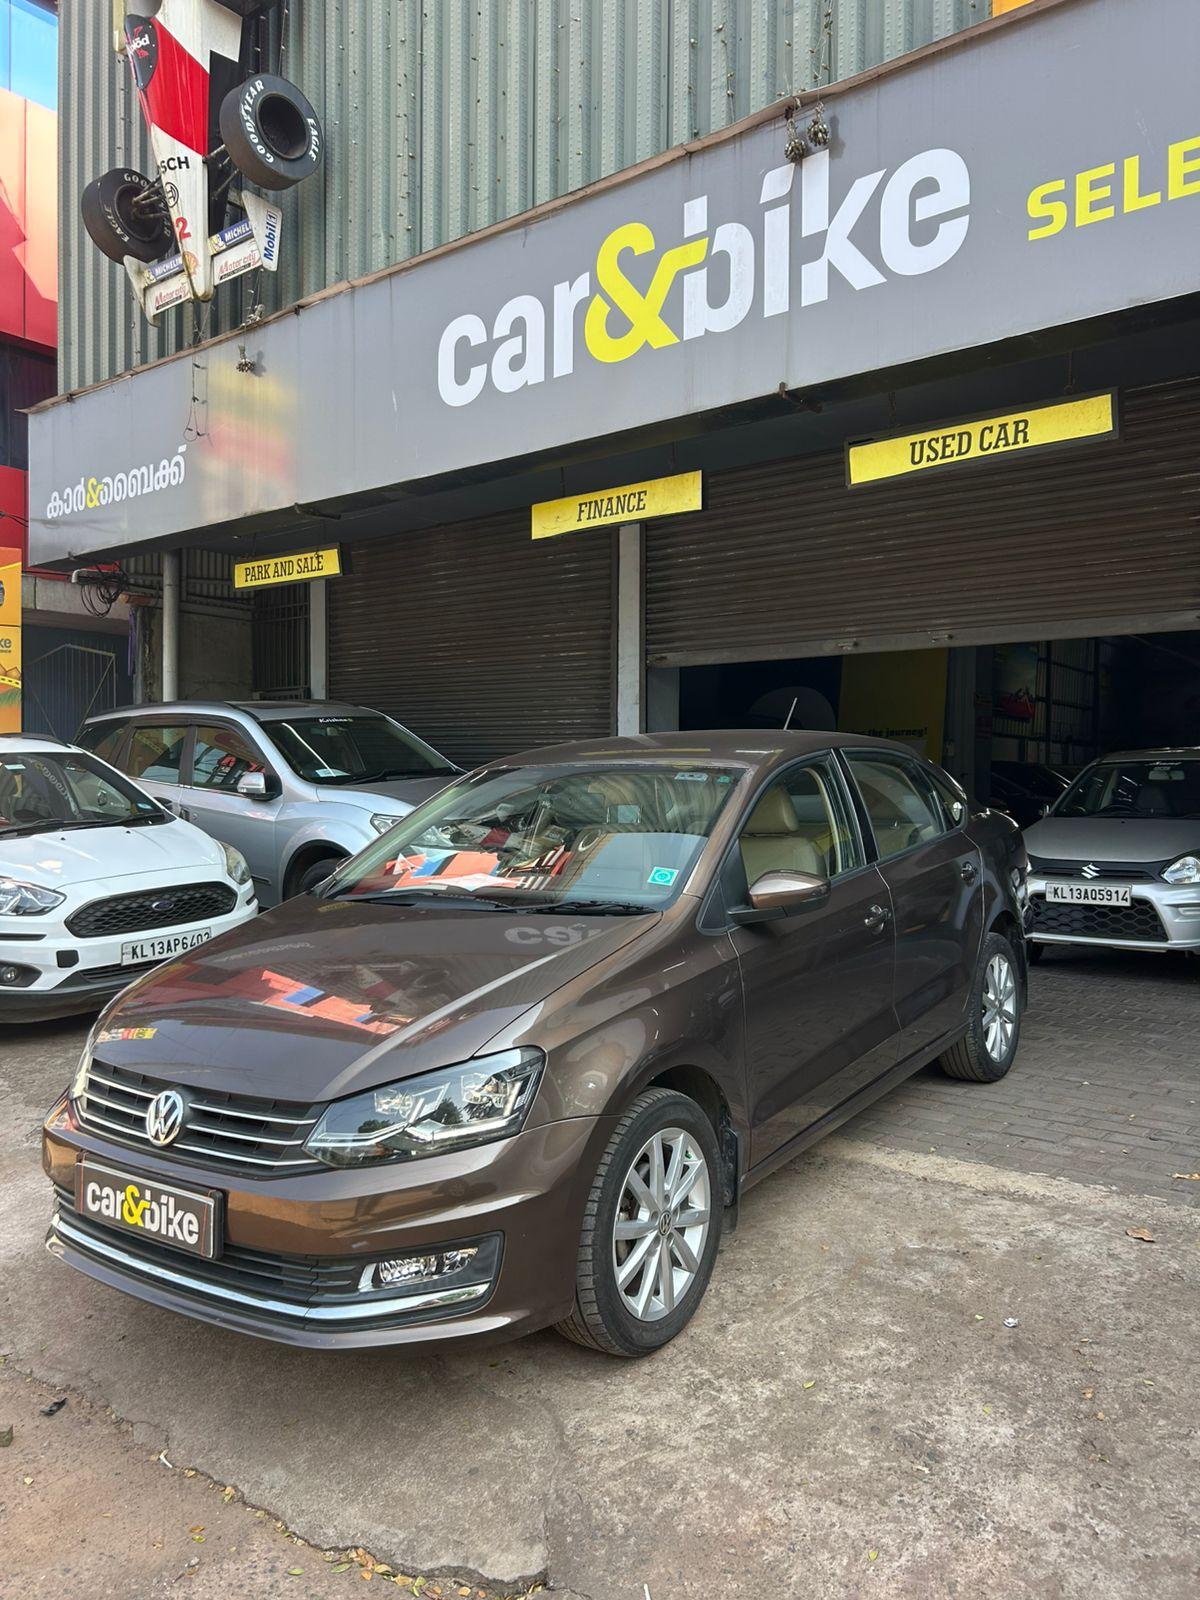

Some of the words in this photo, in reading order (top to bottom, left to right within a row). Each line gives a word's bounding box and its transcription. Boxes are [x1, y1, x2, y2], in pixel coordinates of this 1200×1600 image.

[240, 80, 274, 163] GOODYEAR
[306, 118, 320, 162] EAGLE
[1027, 136, 1200, 241] SELE
[175, 217, 191, 240] 2
[438, 148, 970, 407] car&bike
[909, 430, 972, 465] USED
[979, 419, 1030, 452] CAR
[576, 490, 648, 522] FINANCE
[244, 563, 271, 583] PARK
[272, 560, 295, 578] AND
[296, 554, 324, 574] SALE
[1053, 886, 1129, 903] KL13AQ5914
[87, 1182, 200, 1245] car&bike
